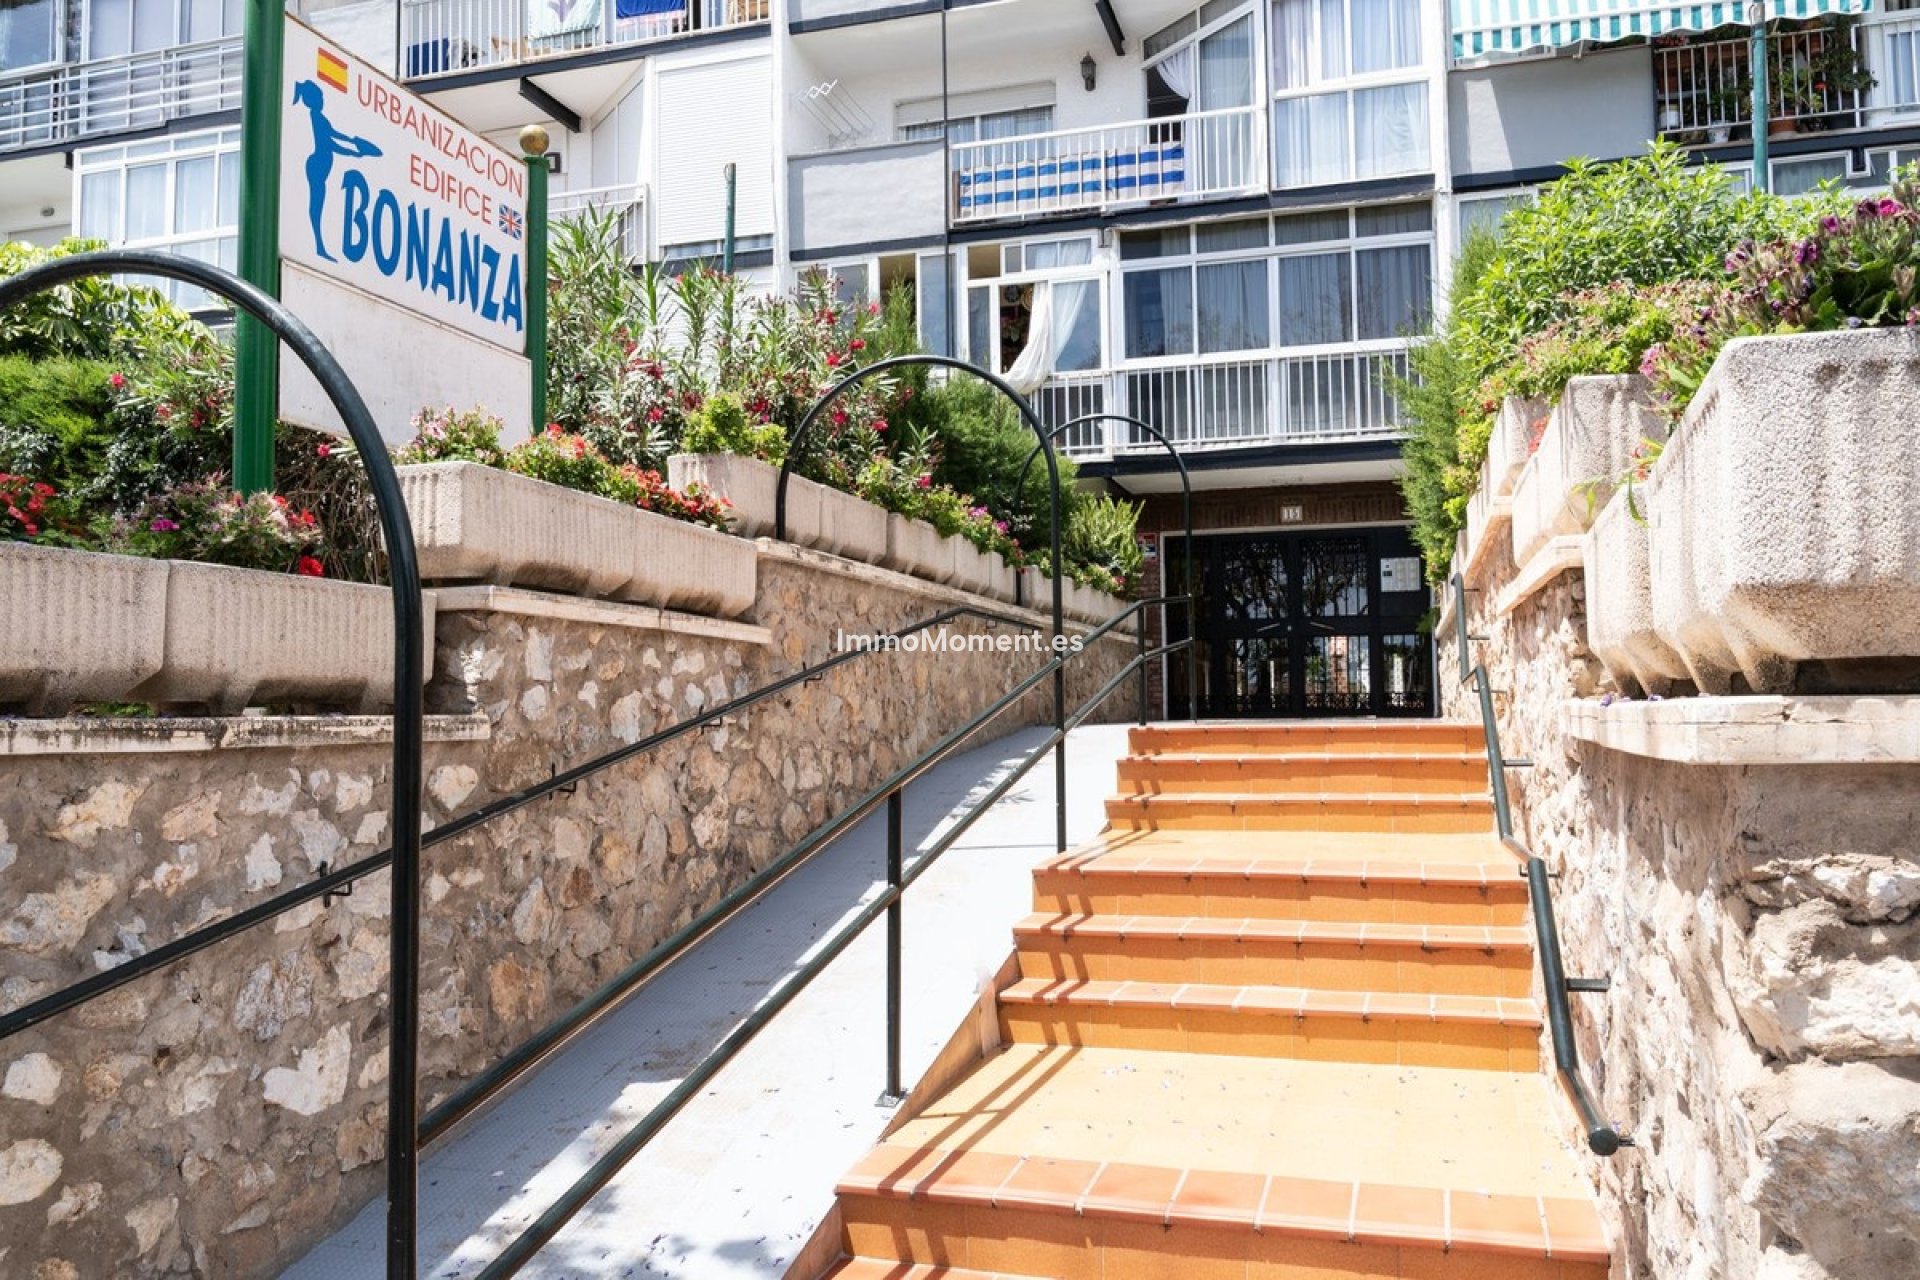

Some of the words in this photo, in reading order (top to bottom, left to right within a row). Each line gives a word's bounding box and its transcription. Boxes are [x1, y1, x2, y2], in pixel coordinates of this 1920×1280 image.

[357, 74, 523, 198] URBANIZACION
[410, 154, 492, 225] EDIFICE
[341, 169, 523, 332] BONANZA
